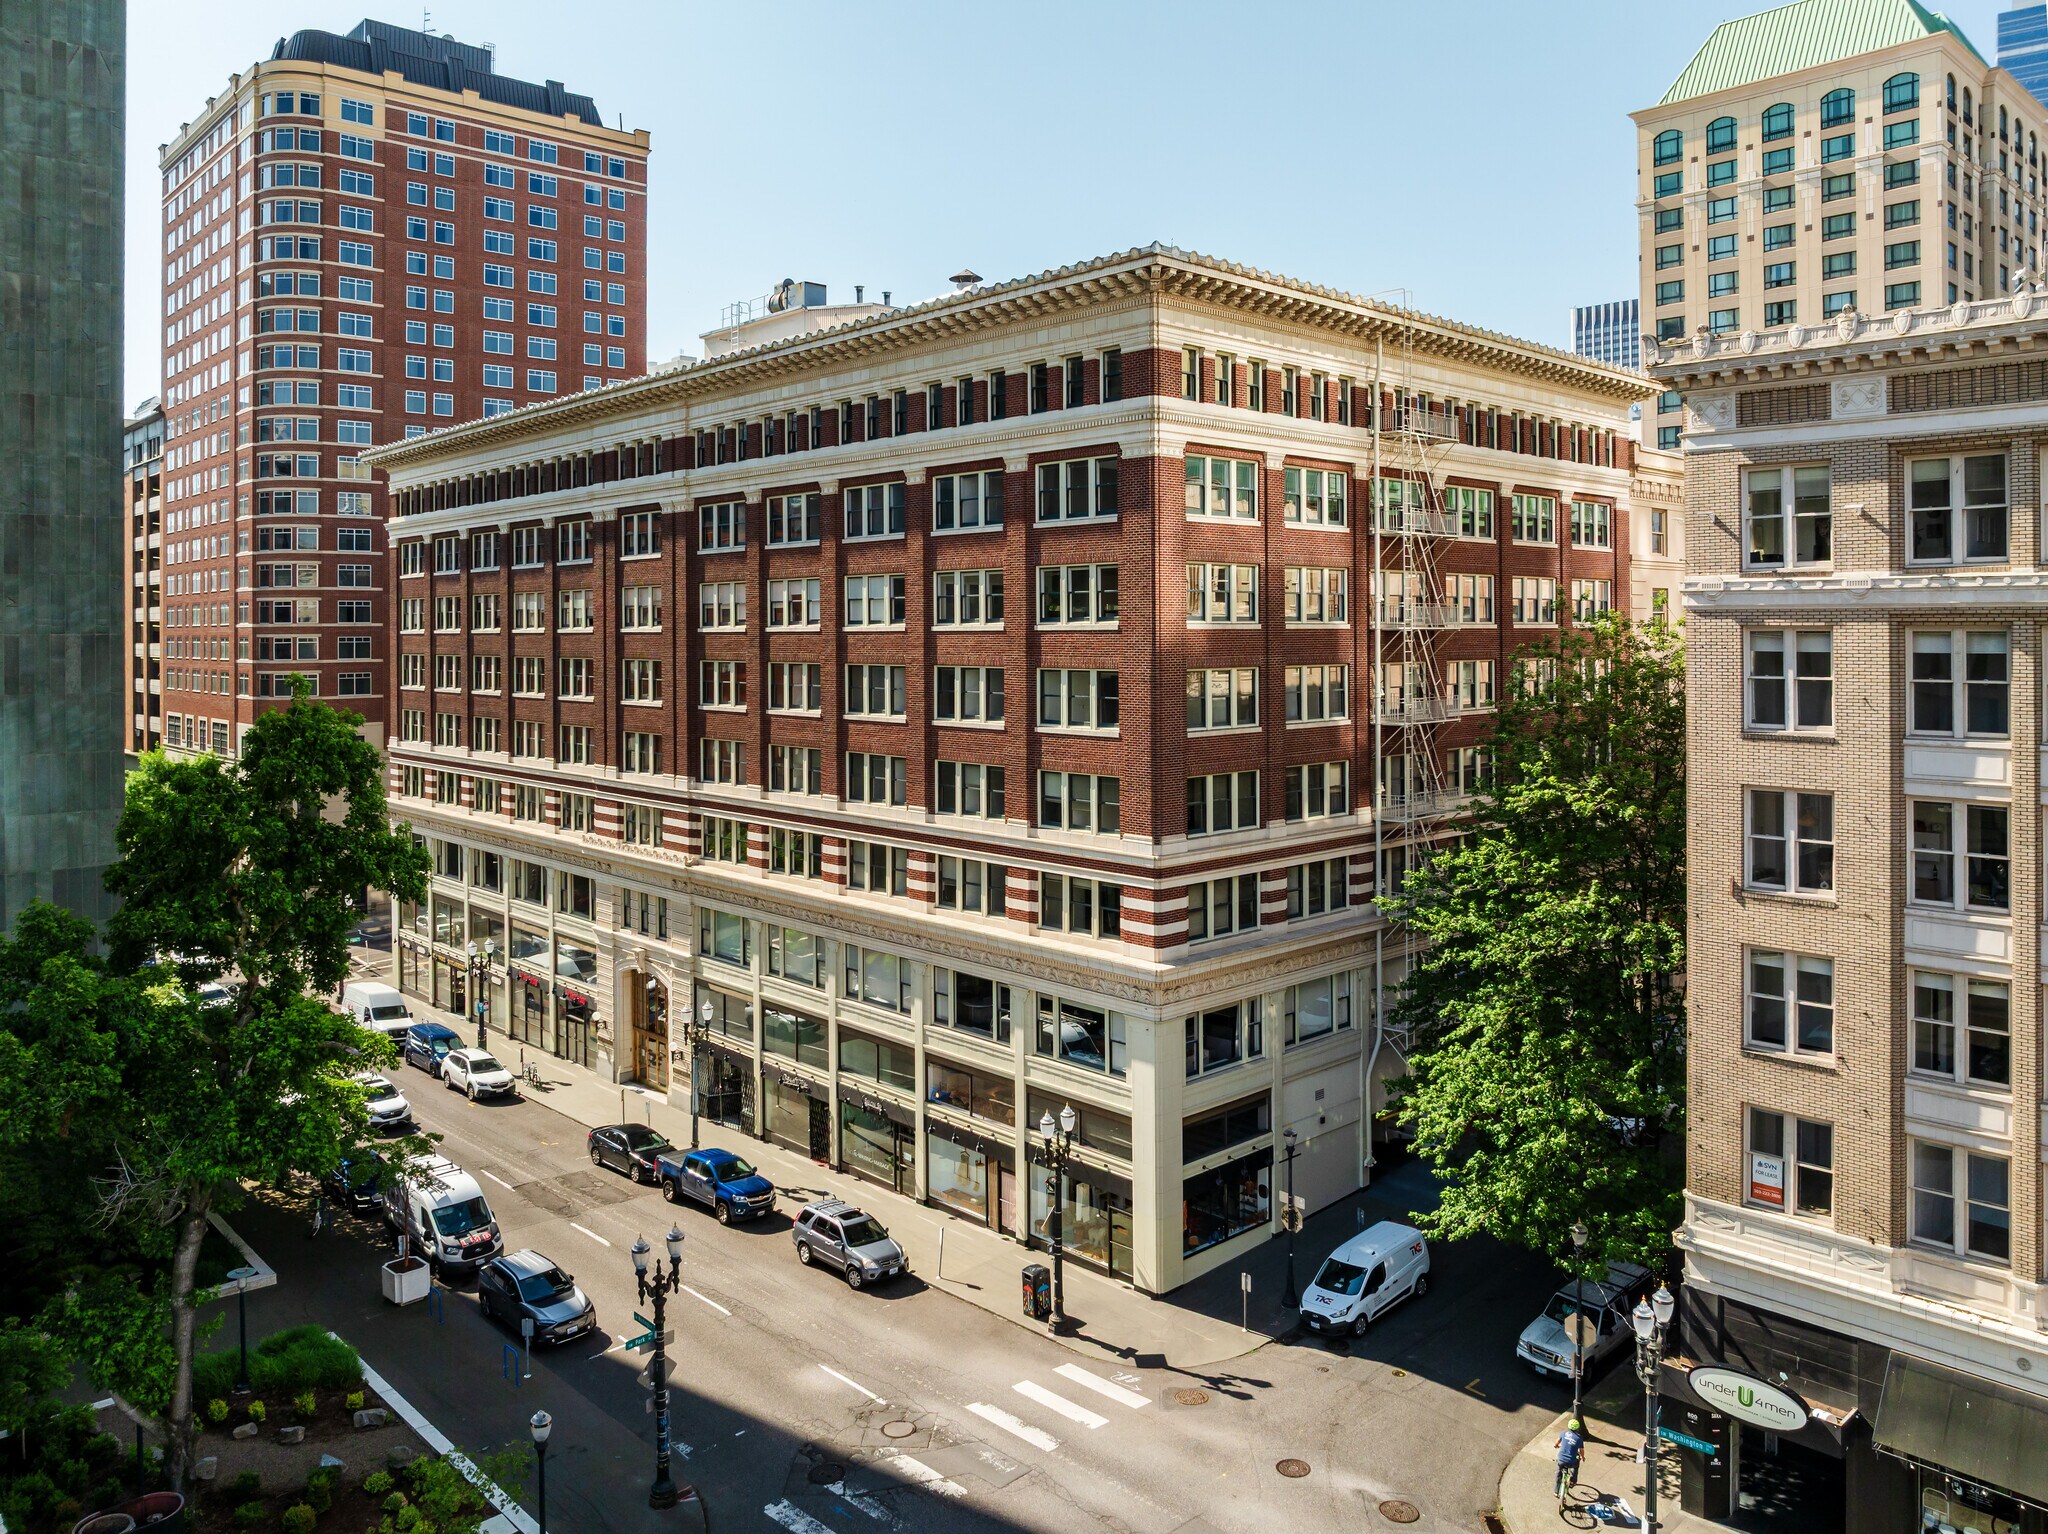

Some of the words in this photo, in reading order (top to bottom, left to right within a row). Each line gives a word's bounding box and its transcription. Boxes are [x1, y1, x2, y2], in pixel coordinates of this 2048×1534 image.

[1764, 1162, 1777, 1171] SVN
[1764, 1172, 1778, 1180] LEASE
[1409, 1242, 1422, 1256] TKE
[1315, 1294, 1334, 1305] TKE
[635, 1337, 646, 1345] Park
[1668, 1432, 1704, 1450] Washington
